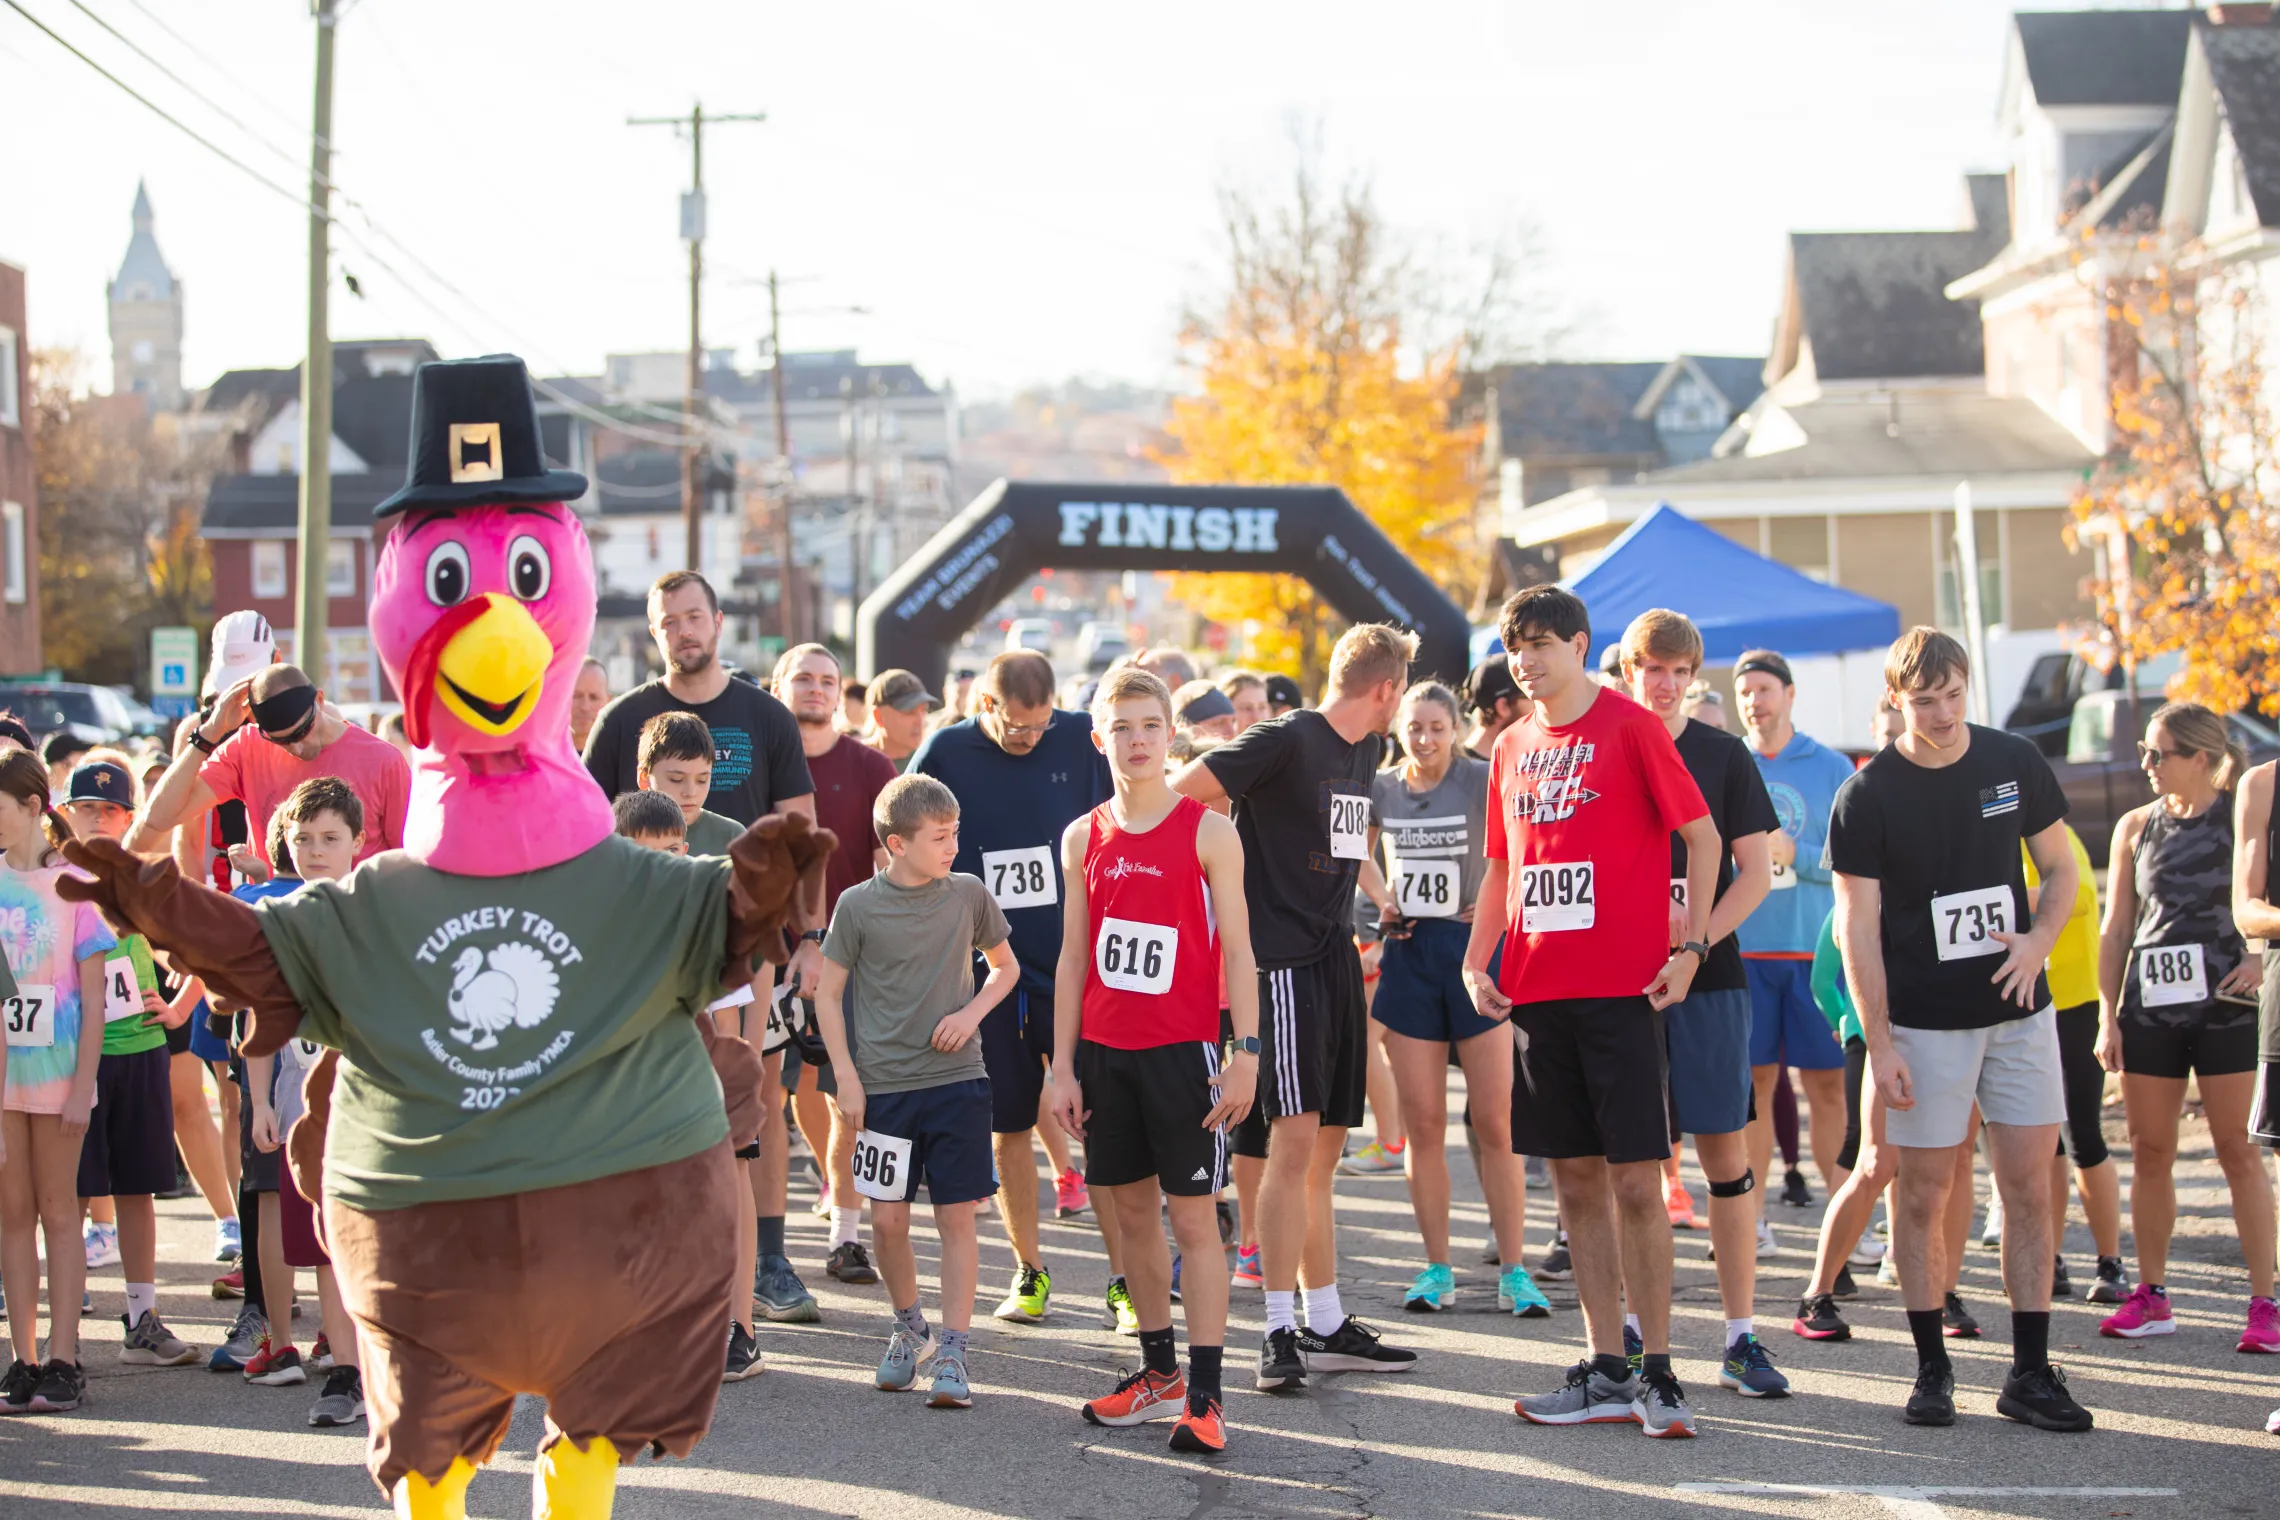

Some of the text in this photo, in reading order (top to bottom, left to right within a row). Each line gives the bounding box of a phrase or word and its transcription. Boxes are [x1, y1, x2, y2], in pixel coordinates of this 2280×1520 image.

[1058, 501, 1279, 552] FINISH
[715, 750, 731, 760] EY
[731, 755, 751, 763] LEARN
[1531, 776, 1583, 824] XC
[993, 860, 1045, 897] 738
[1402, 873, 1449, 904] 748
[1523, 867, 1593, 908] 2092
[416, 906, 584, 967] TURKEY TROT
[1945, 901, 2005, 945] 735
[1104, 933, 1164, 979] 616
[2146, 950, 2193, 985] 488
[1, 998, 43, 1033] 37
[420, 1028, 575, 1085] Butler County Family YMCA
[853, 1140, 897, 1187] 696
[1300, 1336, 1326, 1350] ERS
